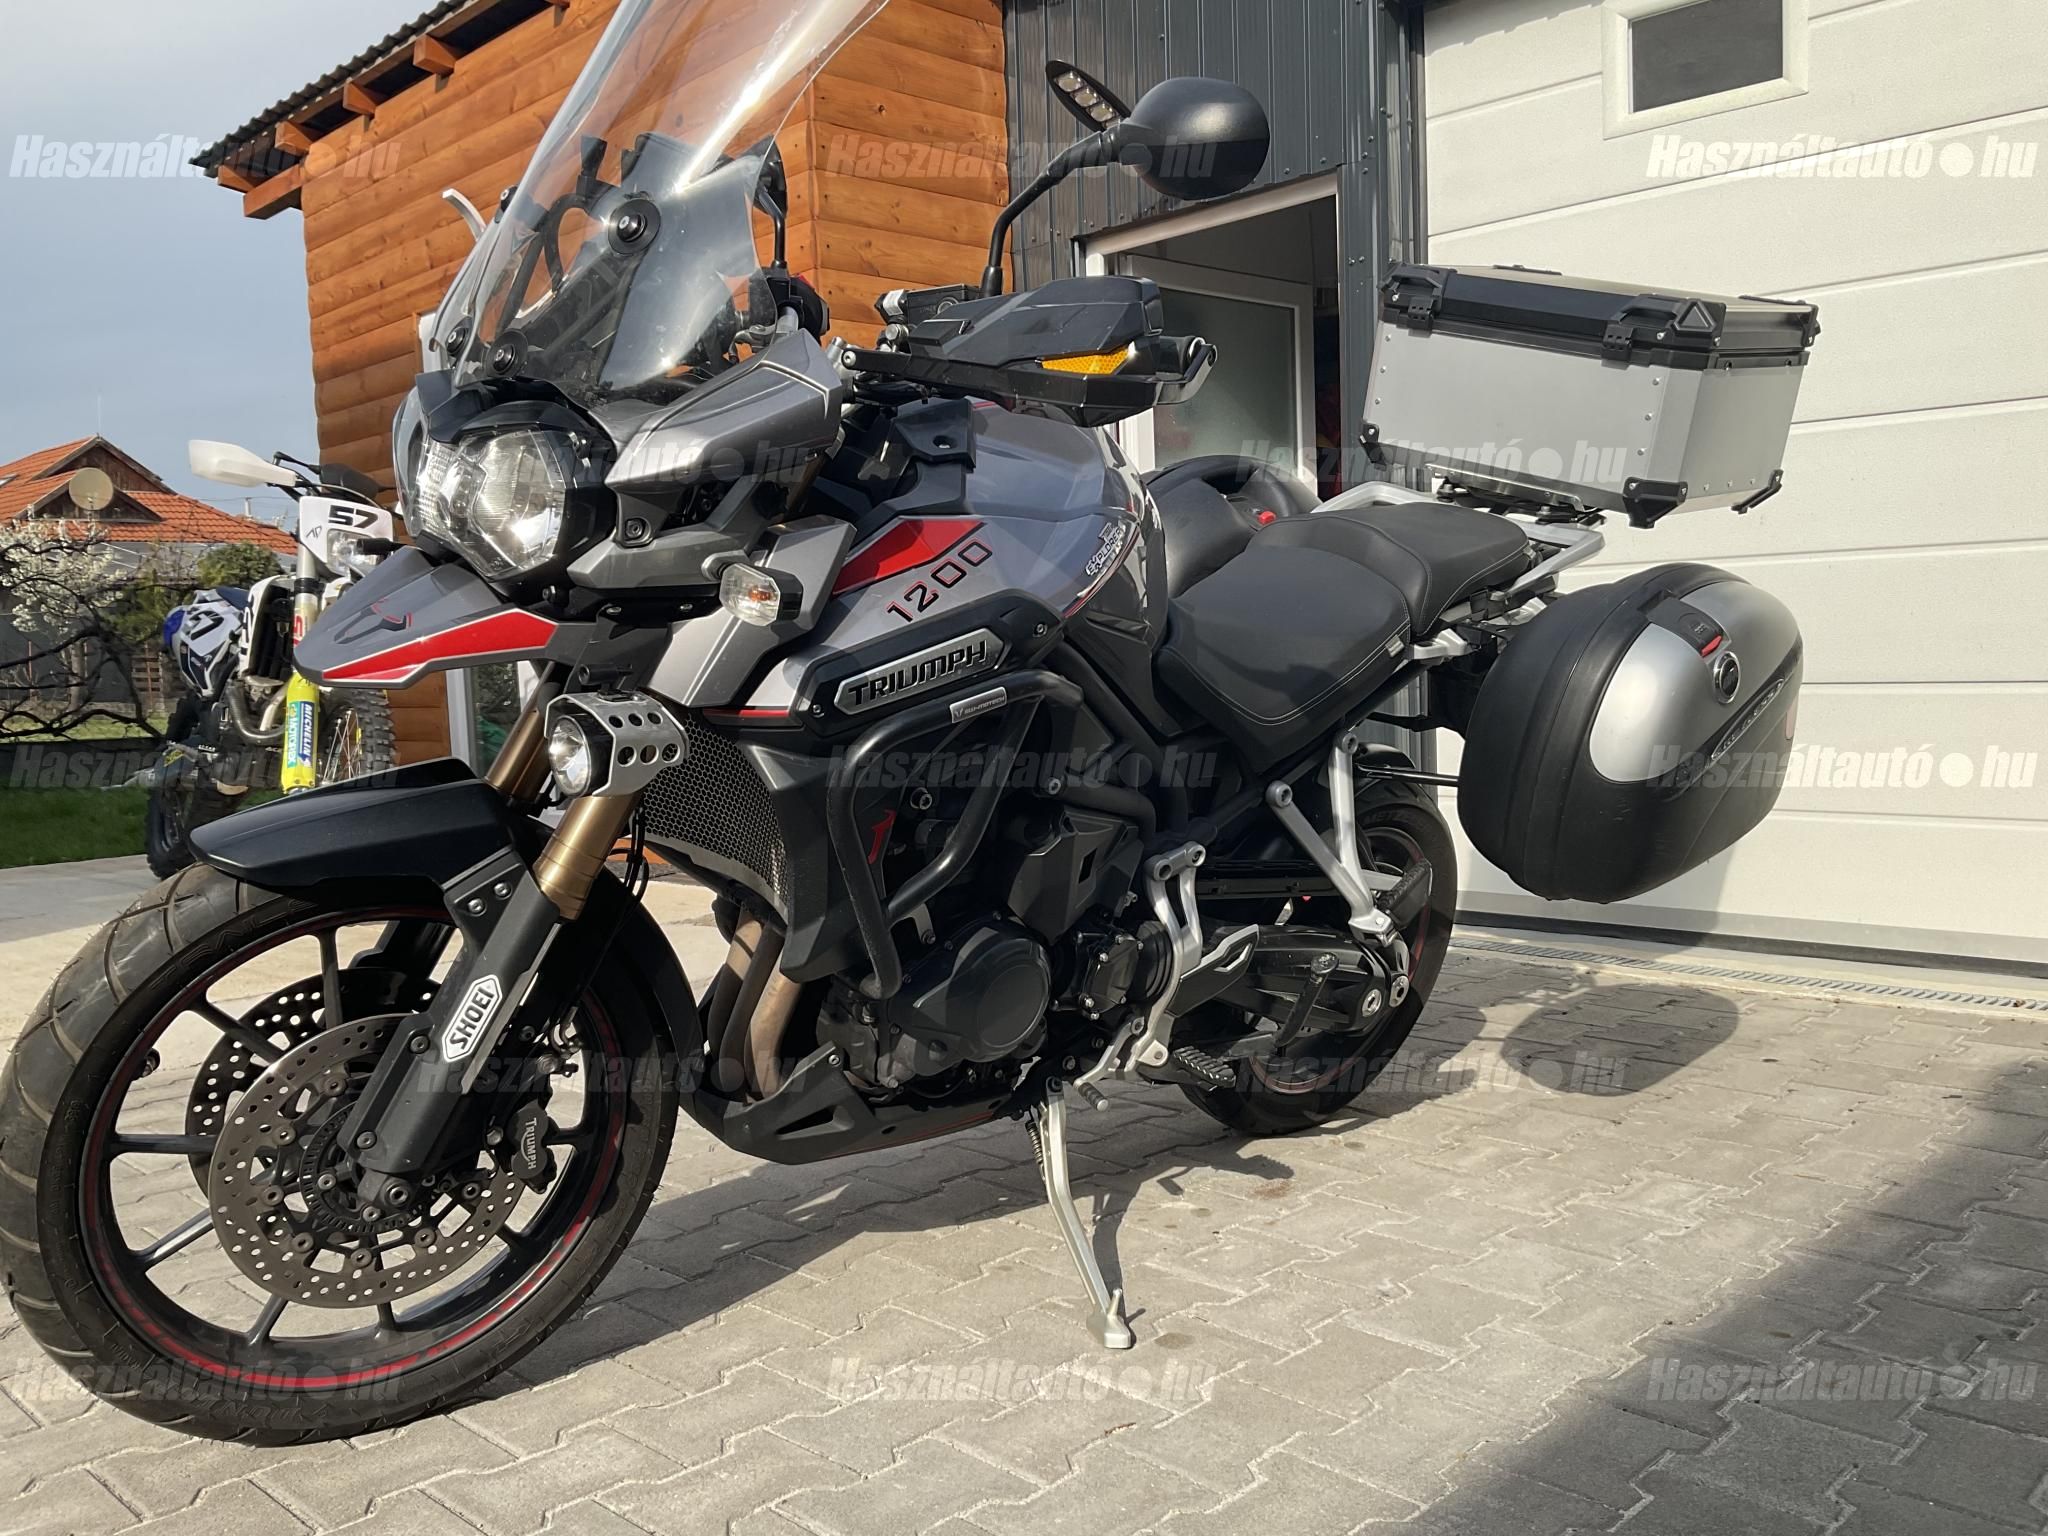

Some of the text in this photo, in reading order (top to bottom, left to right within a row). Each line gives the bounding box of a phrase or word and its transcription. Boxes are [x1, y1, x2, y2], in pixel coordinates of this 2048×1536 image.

[328, 504, 378, 529] 57
[886, 537, 993, 622] 1200
[848, 640, 987, 706] TRIUMPH
[303, 703, 313, 757] MICHELIN
[449, 986, 496, 1050] SHOEI
[521, 1117, 538, 1170] TRIUMPH
